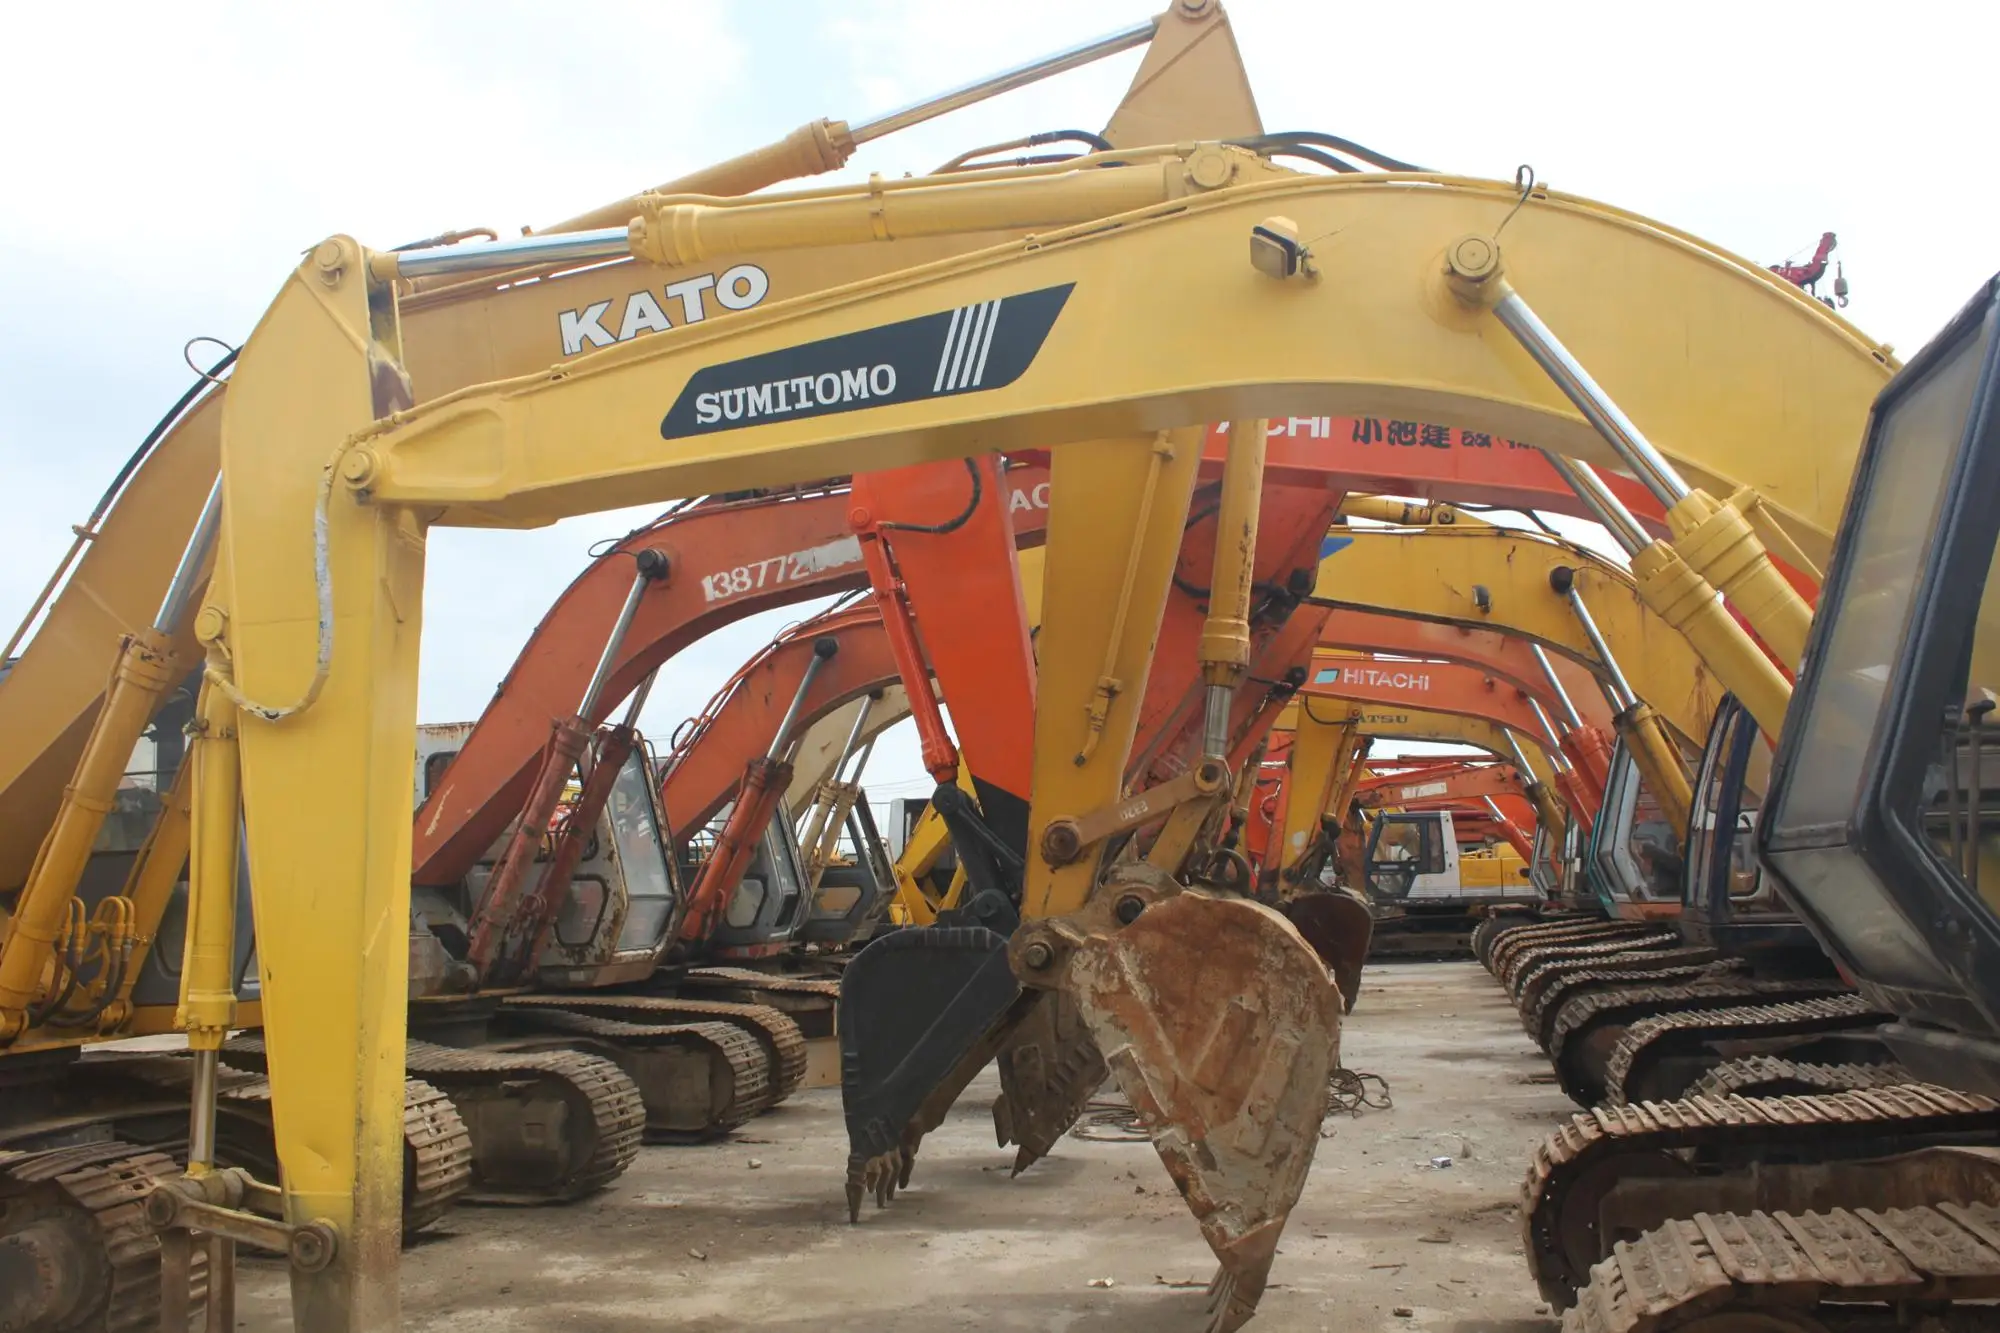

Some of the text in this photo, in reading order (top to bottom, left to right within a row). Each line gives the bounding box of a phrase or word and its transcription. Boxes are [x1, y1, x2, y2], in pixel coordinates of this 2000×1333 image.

[559, 264, 769, 356] KATO
[696, 364, 896, 424] SUMITOMO
[1344, 668, 1430, 691] HITACHI
